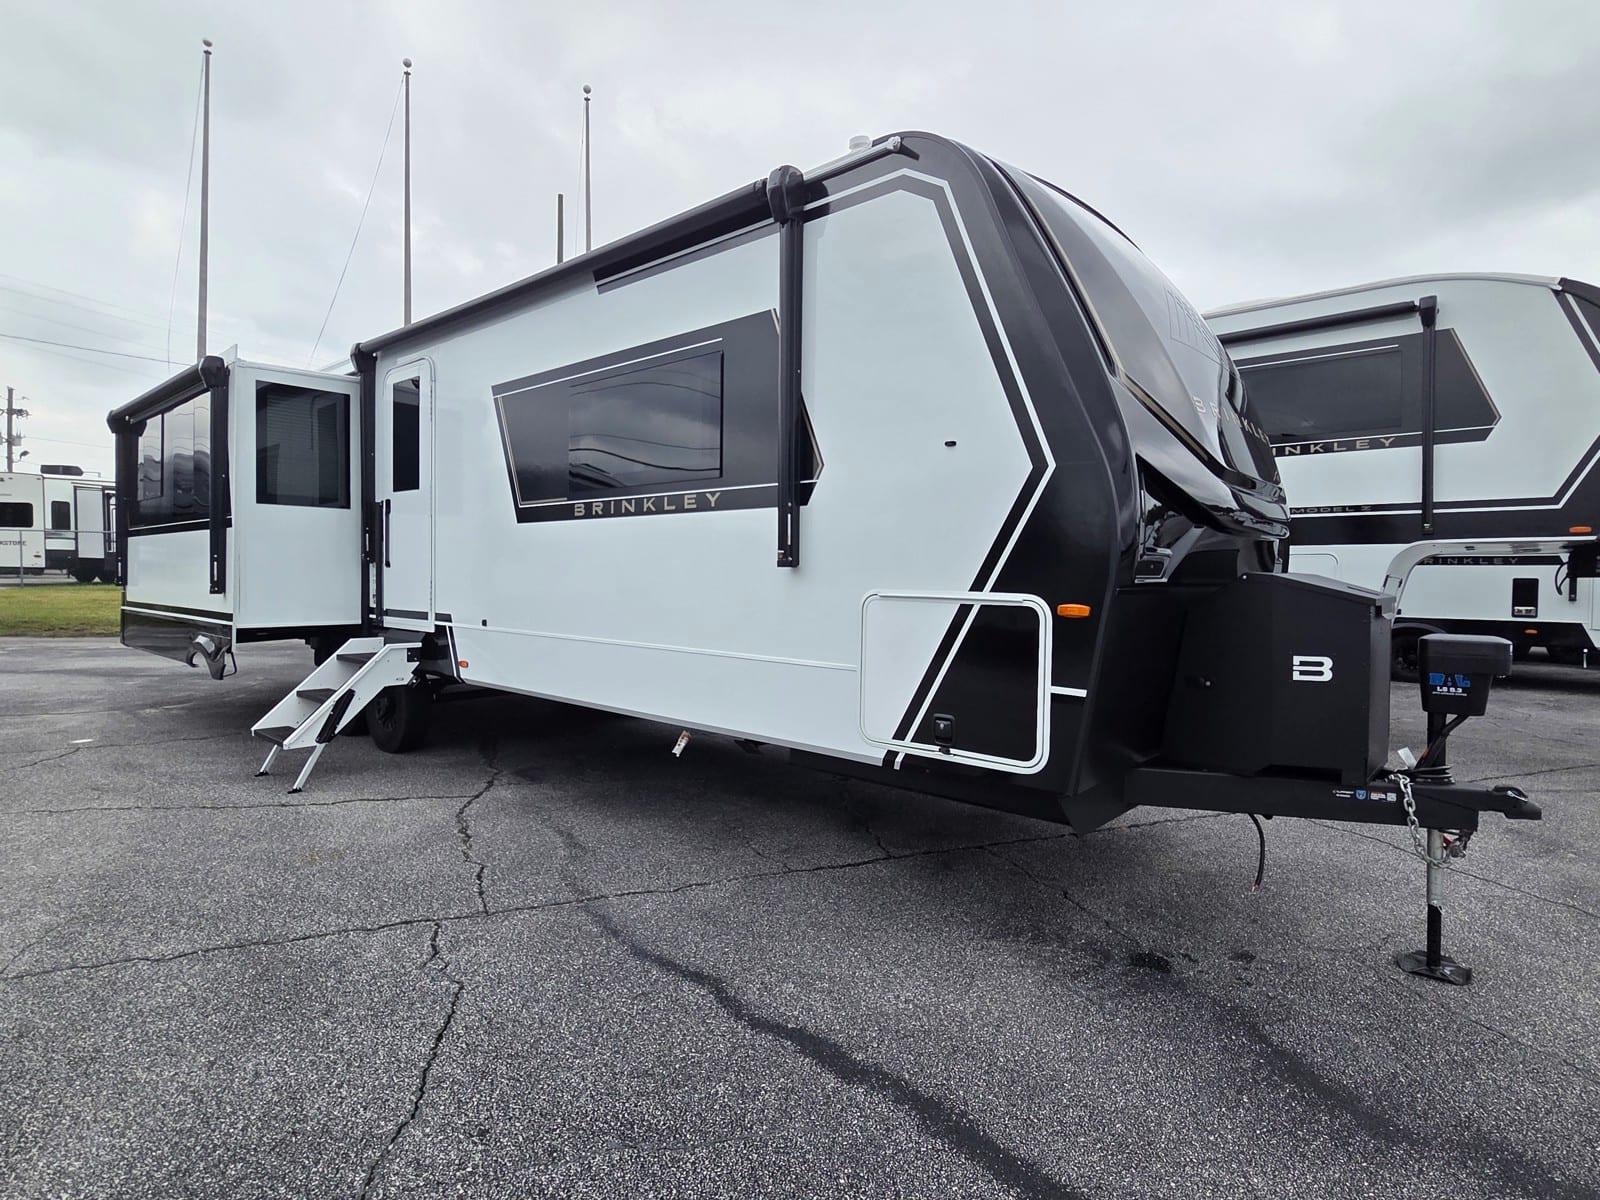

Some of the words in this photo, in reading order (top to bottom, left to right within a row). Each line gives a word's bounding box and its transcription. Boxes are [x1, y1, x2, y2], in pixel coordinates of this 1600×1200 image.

[1271, 437, 1395, 456] INKLEY
[573, 492, 721, 517] BRINKLEY
[1423, 557, 1519, 565] RINKLEY
[1293, 655, 1334, 682] B
